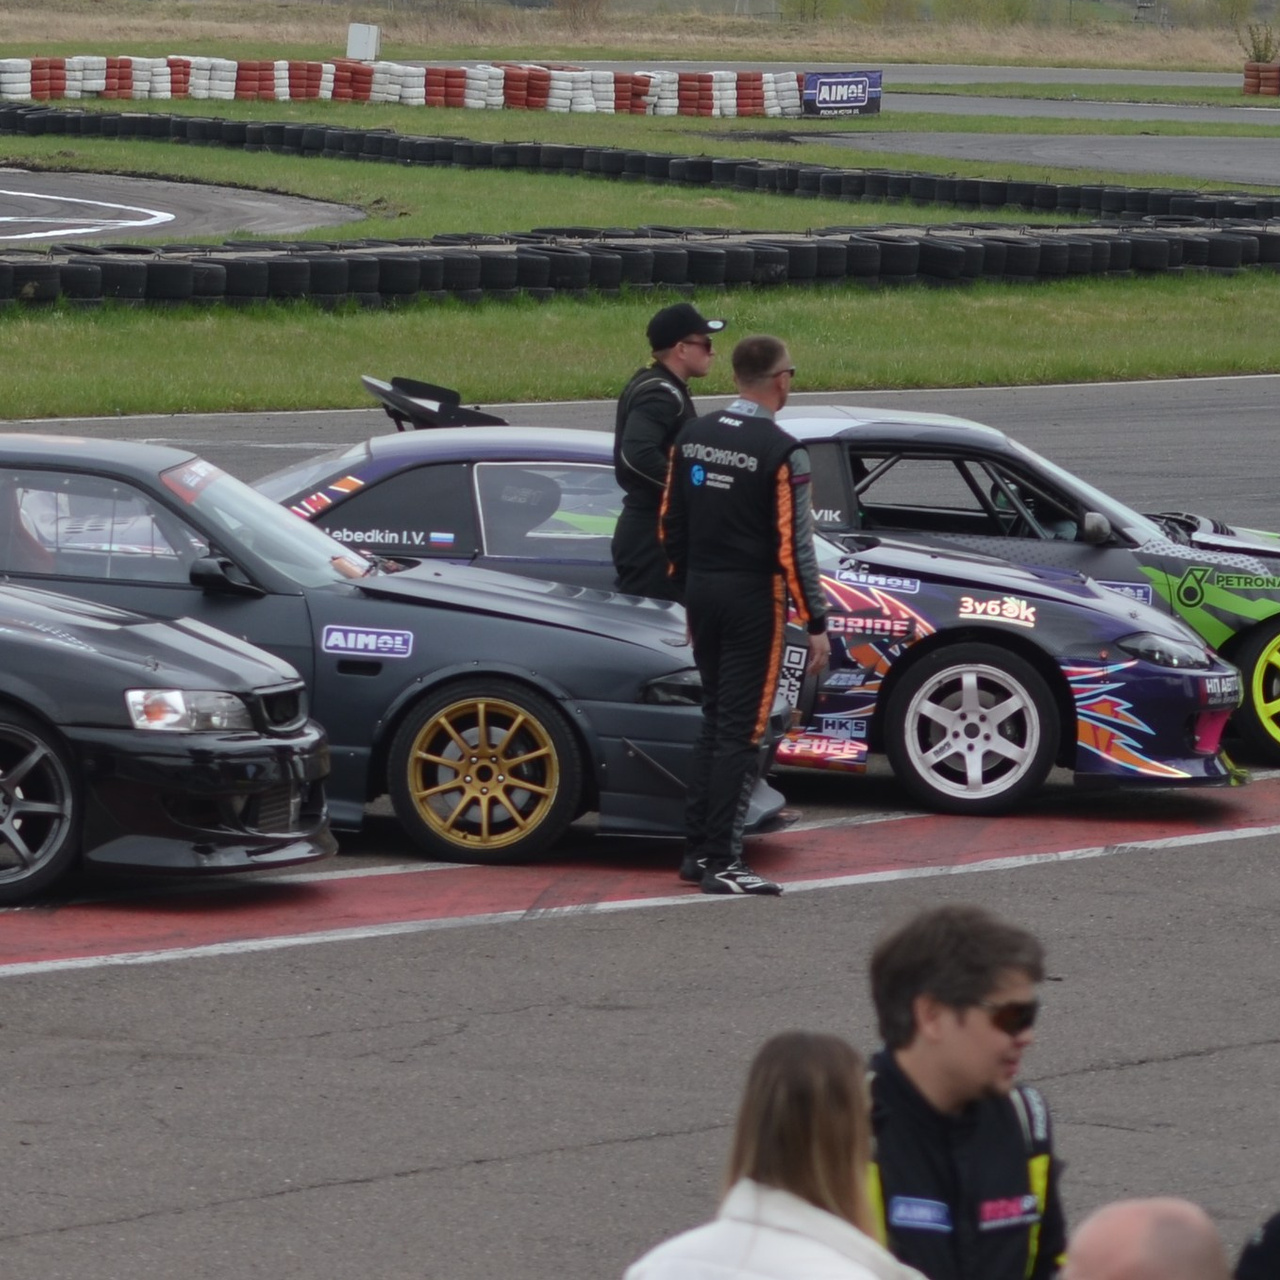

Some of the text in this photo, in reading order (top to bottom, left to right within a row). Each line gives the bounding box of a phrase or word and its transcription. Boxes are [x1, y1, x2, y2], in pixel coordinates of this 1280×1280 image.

[819, 83, 866, 101] AIMOL
[827, 615, 910, 637] BRIDE
[326, 630, 408, 652] AIMOL
[823, 719, 866, 732] HKS
